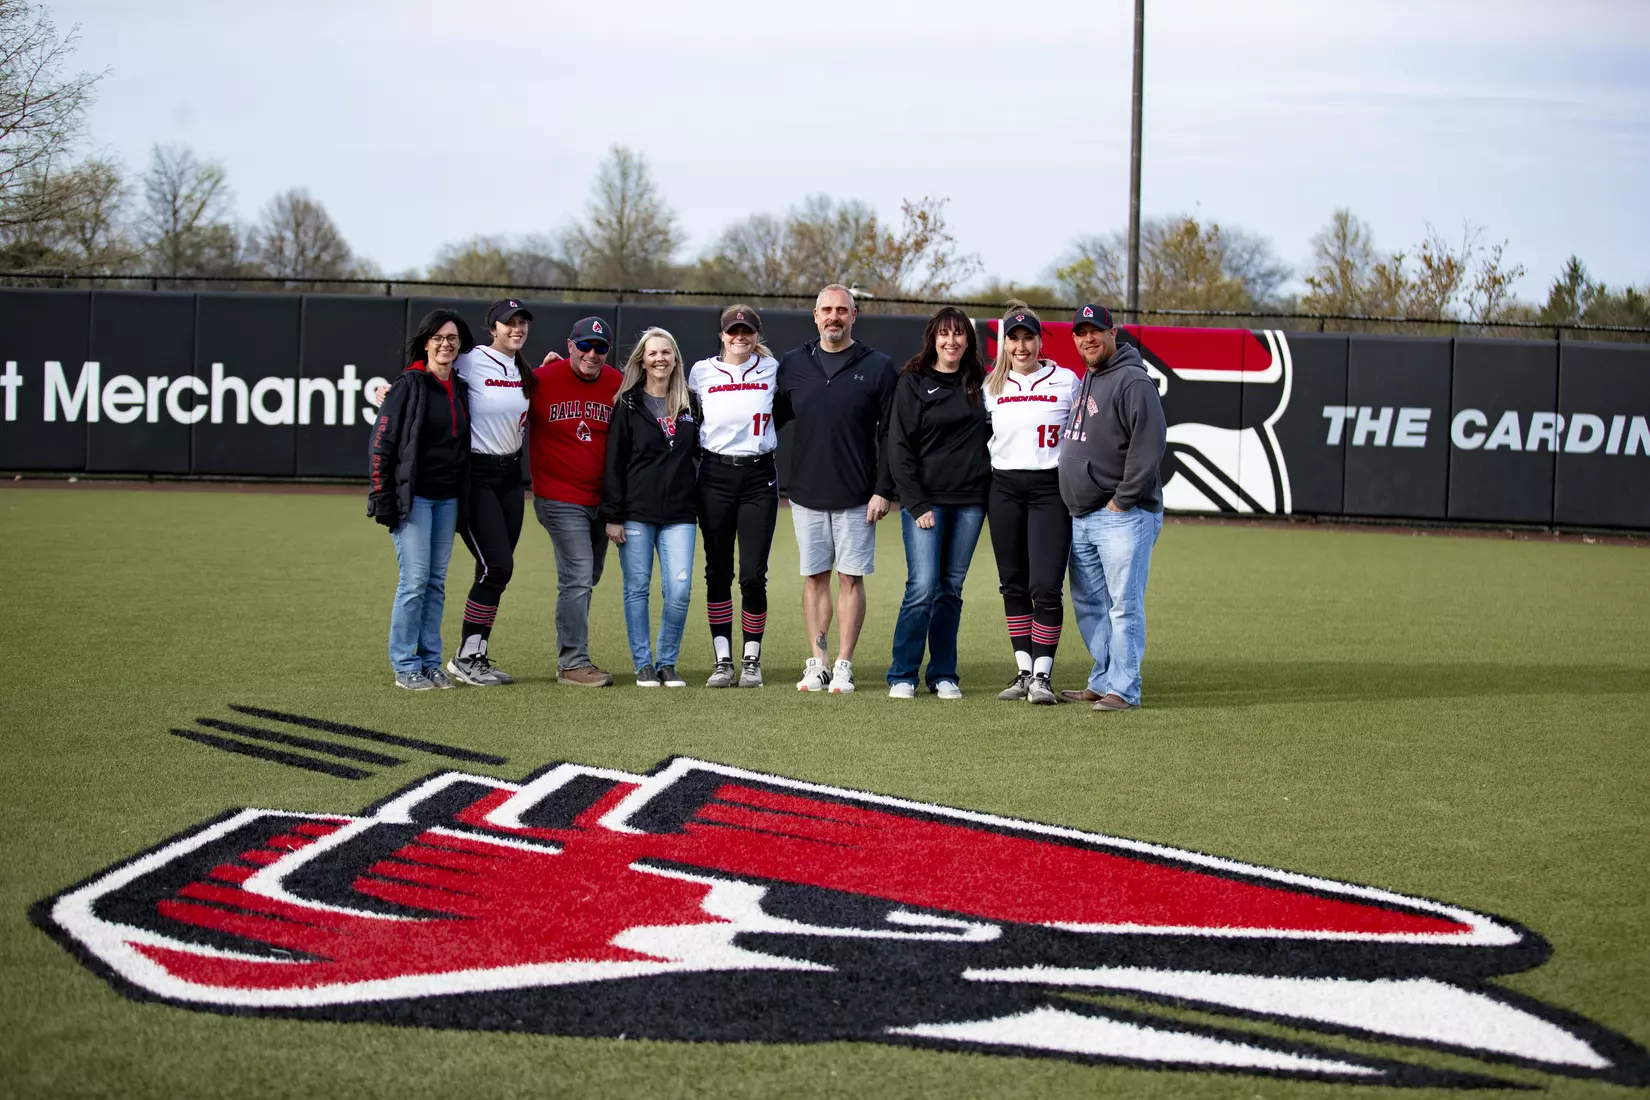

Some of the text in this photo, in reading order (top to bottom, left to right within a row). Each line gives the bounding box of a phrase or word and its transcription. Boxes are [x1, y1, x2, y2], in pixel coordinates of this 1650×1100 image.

[43, 361, 392, 425] Merchants
[708, 383, 769, 394] CARDINALS
[997, 394, 1058, 405] CARDINALS
[548, 400, 582, 422] BALL
[752, 413, 772, 437] 17
[1036, 424, 1061, 448] 13
[1322, 405, 1432, 448] THE
